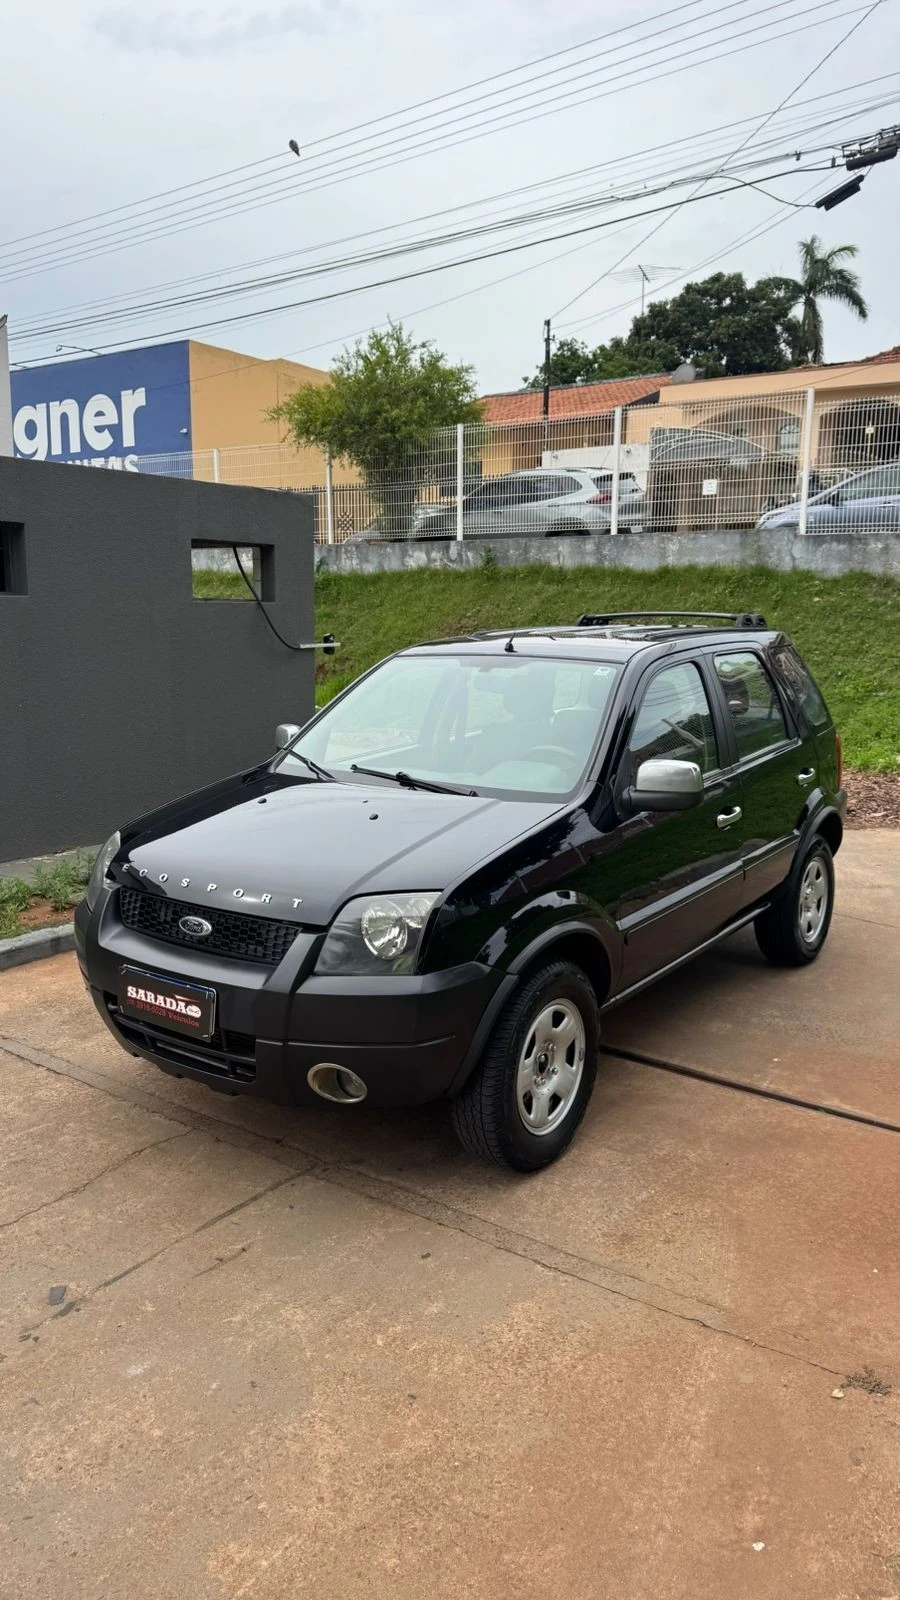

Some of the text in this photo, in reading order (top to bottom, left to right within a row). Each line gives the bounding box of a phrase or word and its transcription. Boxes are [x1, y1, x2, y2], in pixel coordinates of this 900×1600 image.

[13, 387, 146, 461] gner
[122, 864, 302, 909] ECOSPORT
[127, 986, 187, 1014] SARADA
